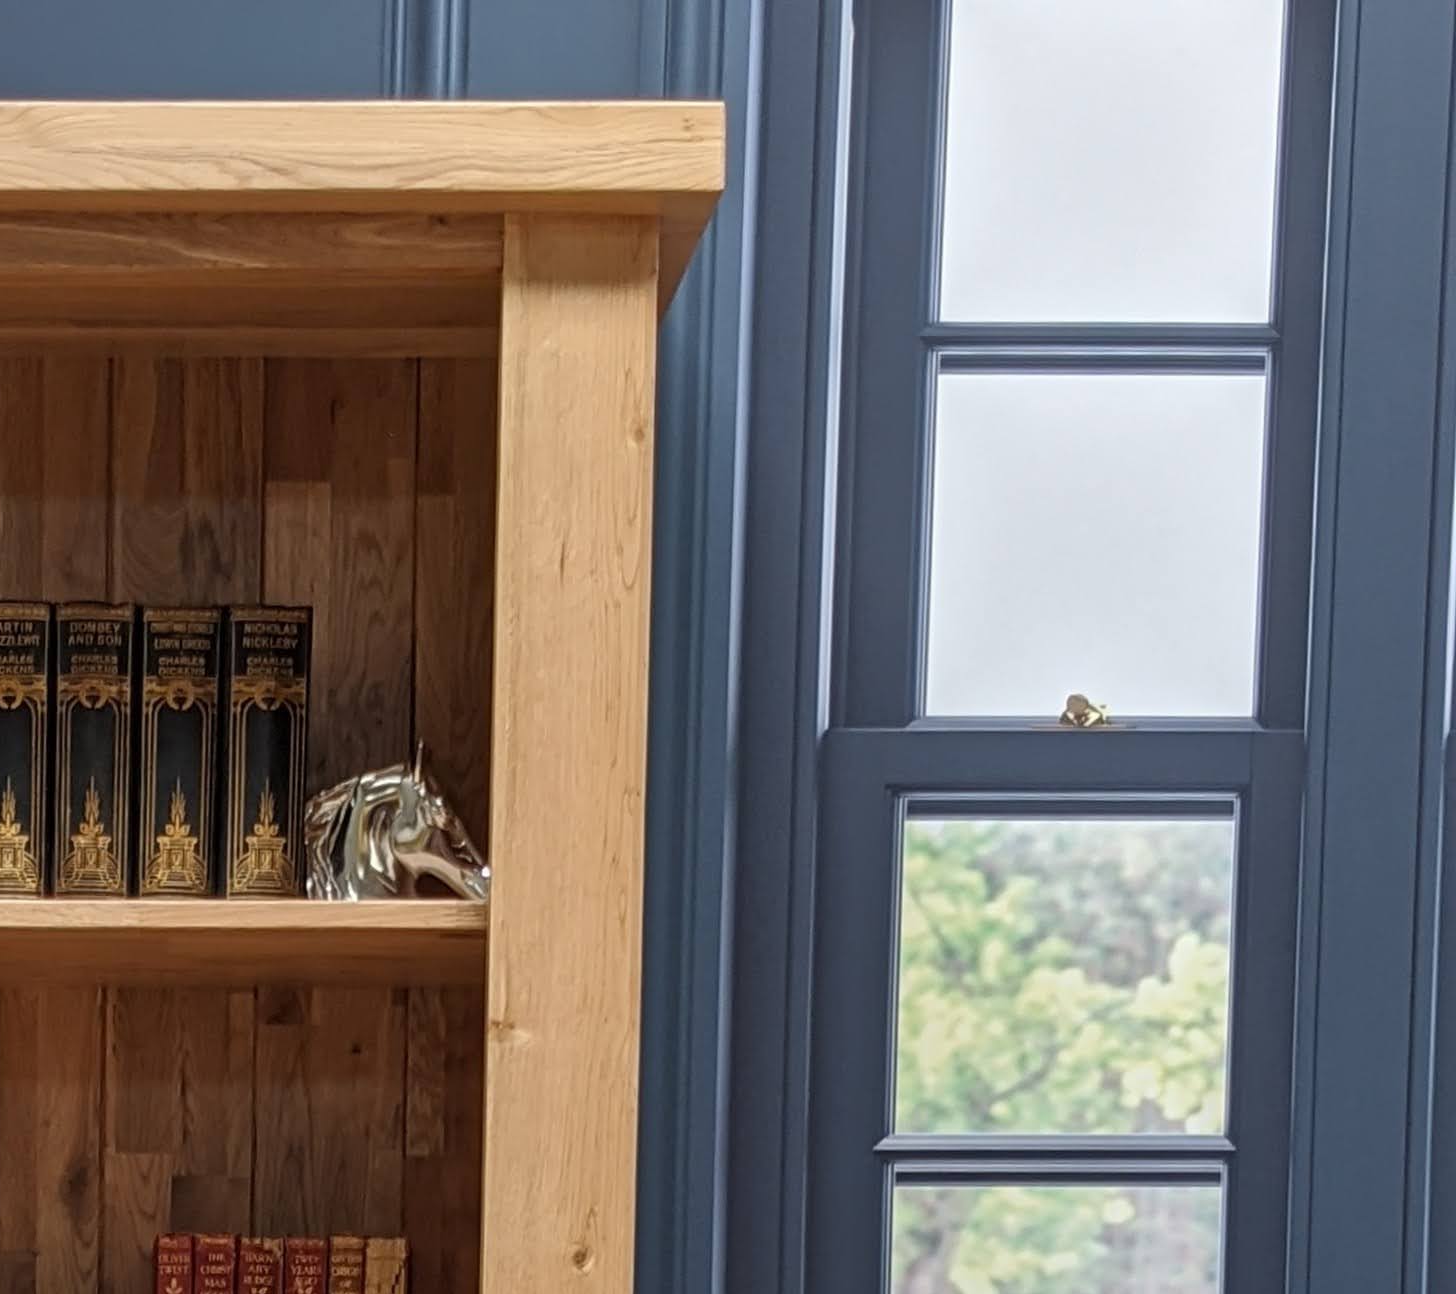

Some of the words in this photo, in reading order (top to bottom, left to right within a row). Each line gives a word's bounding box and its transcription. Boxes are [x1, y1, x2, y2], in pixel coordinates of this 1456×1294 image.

[70, 621, 121, 633] DOMBEY
[244, 623, 298, 634] NICHOLAS
[68, 635, 94, 647] AND
[97, 634, 122, 648] SON
[242, 636, 299, 649] NICKLEBY
